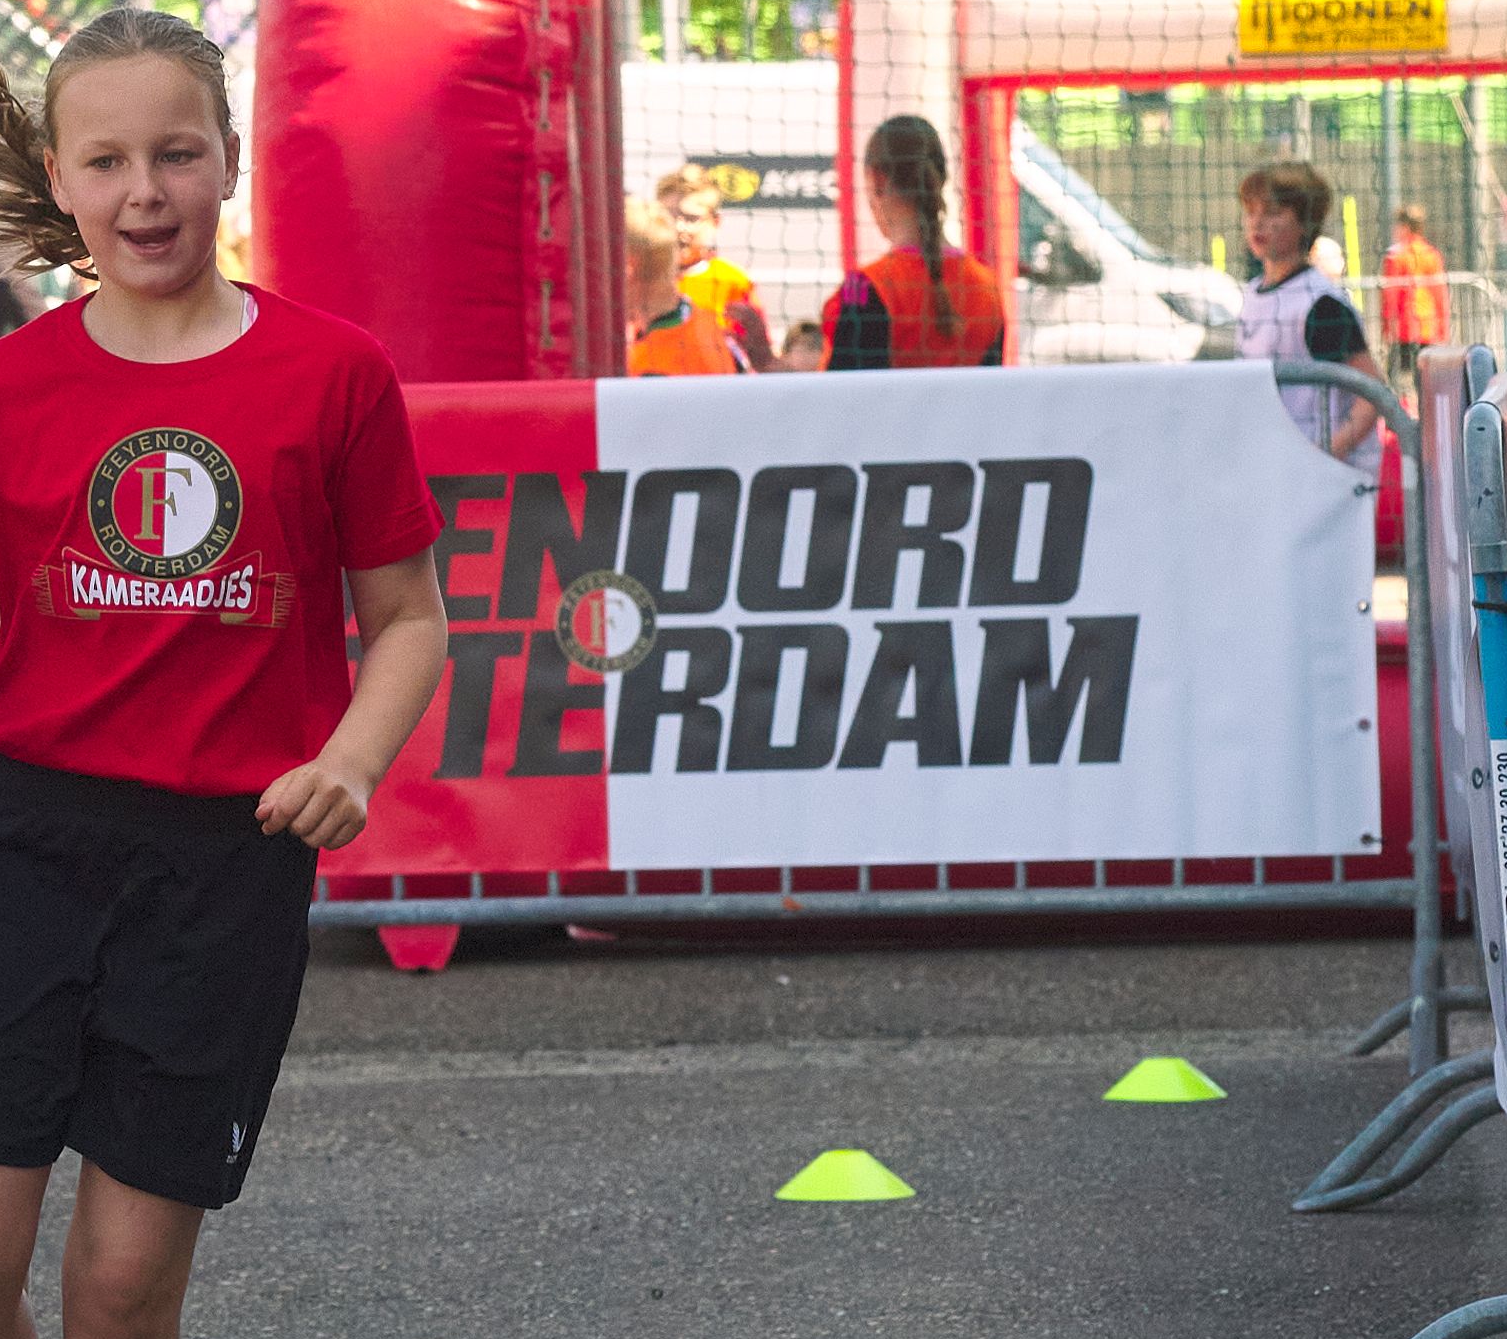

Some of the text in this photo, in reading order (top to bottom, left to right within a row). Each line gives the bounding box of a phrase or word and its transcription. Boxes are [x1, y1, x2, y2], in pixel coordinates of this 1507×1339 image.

[100, 432, 231, 484] FEYENOORD
[99, 524, 231, 577] ROTTERDAM
[425, 456, 1095, 621] ENOORD
[71, 561, 254, 609] KAMERAADJES
[431, 614, 1140, 779] TERDAM
